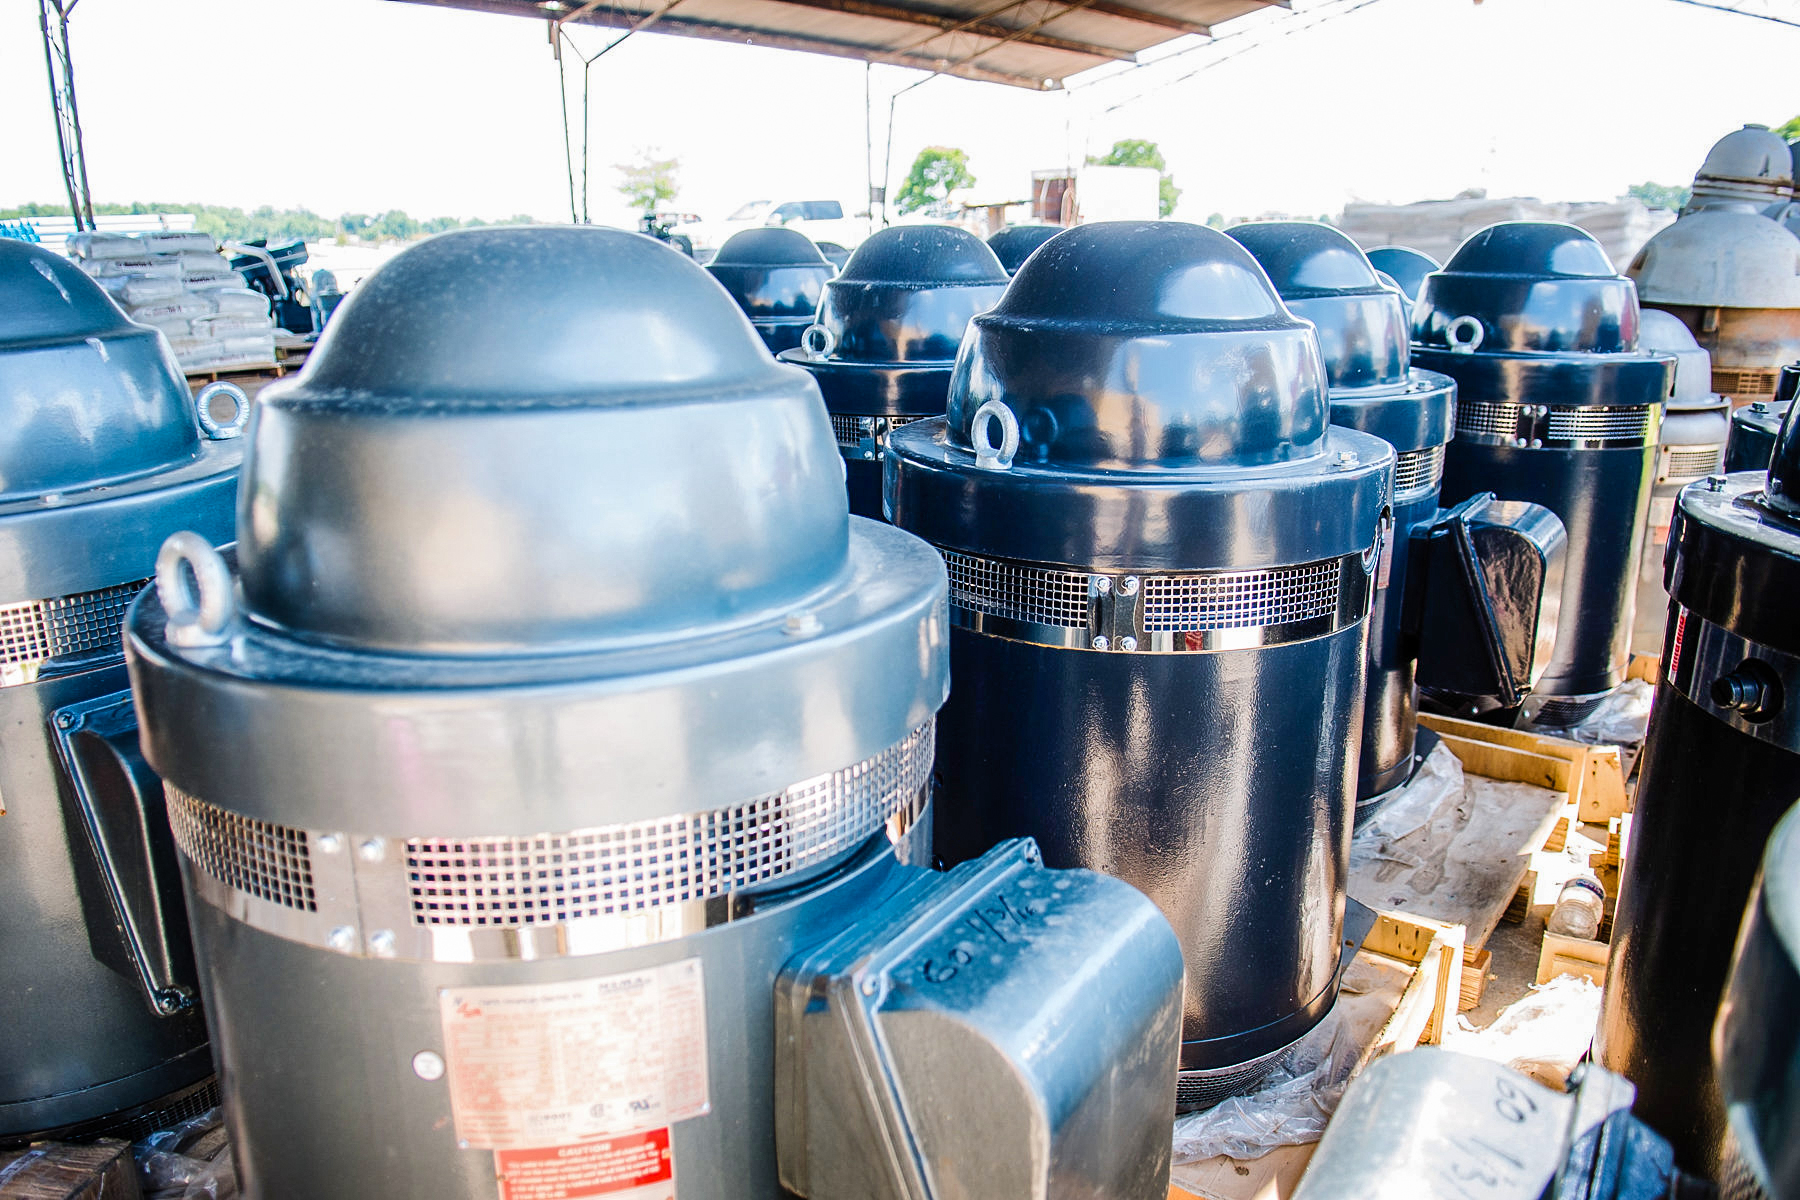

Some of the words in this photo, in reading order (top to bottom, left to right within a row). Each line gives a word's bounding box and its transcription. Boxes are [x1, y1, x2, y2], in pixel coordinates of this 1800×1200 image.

[923, 948, 972, 984] 60
[1495, 1077, 1538, 1123] 60
[558, 1142, 612, 1158] CAUTION
